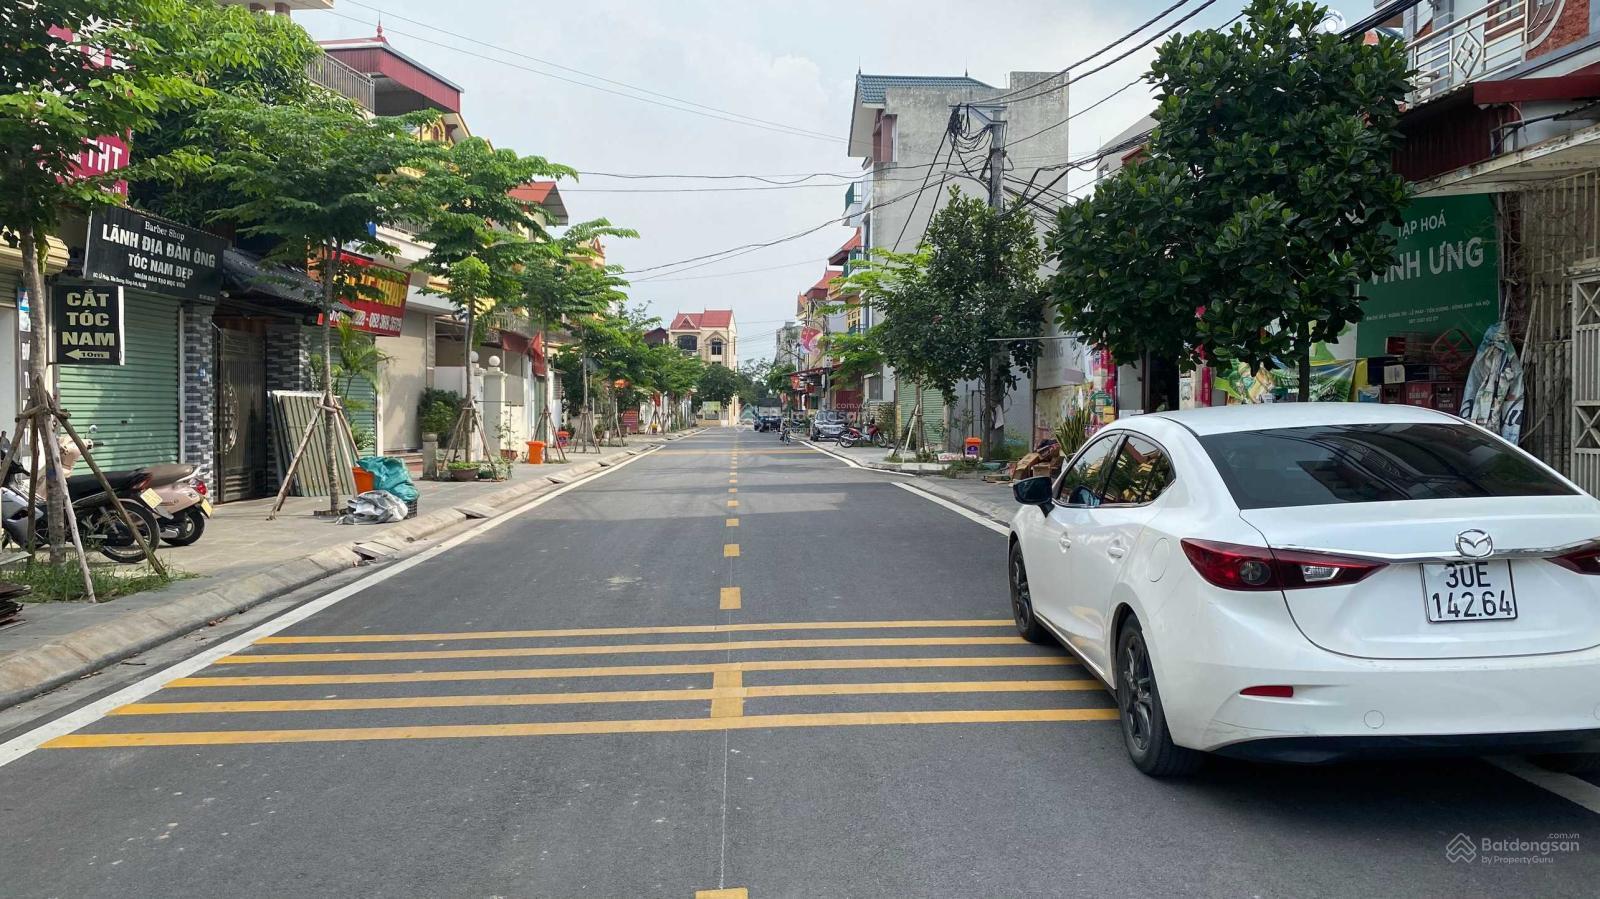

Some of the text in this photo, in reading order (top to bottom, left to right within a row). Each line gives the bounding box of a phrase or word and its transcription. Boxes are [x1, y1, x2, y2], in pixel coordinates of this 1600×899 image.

[144, 220, 185, 242] Barber Shop
[1420, 209, 1447, 233] HOÁ
[102, 223, 216, 268] LÃNH ĐỊA ĐÀN ÔNG
[128, 253, 194, 282] TÓC NAM ĐẸP
[66, 288, 110, 307] CẮT
[66, 309, 110, 327] TÓC
[61, 331, 115, 347] NAM
[1445, 561, 1492, 588] 30E
[1432, 589, 1513, 618] 142.64
